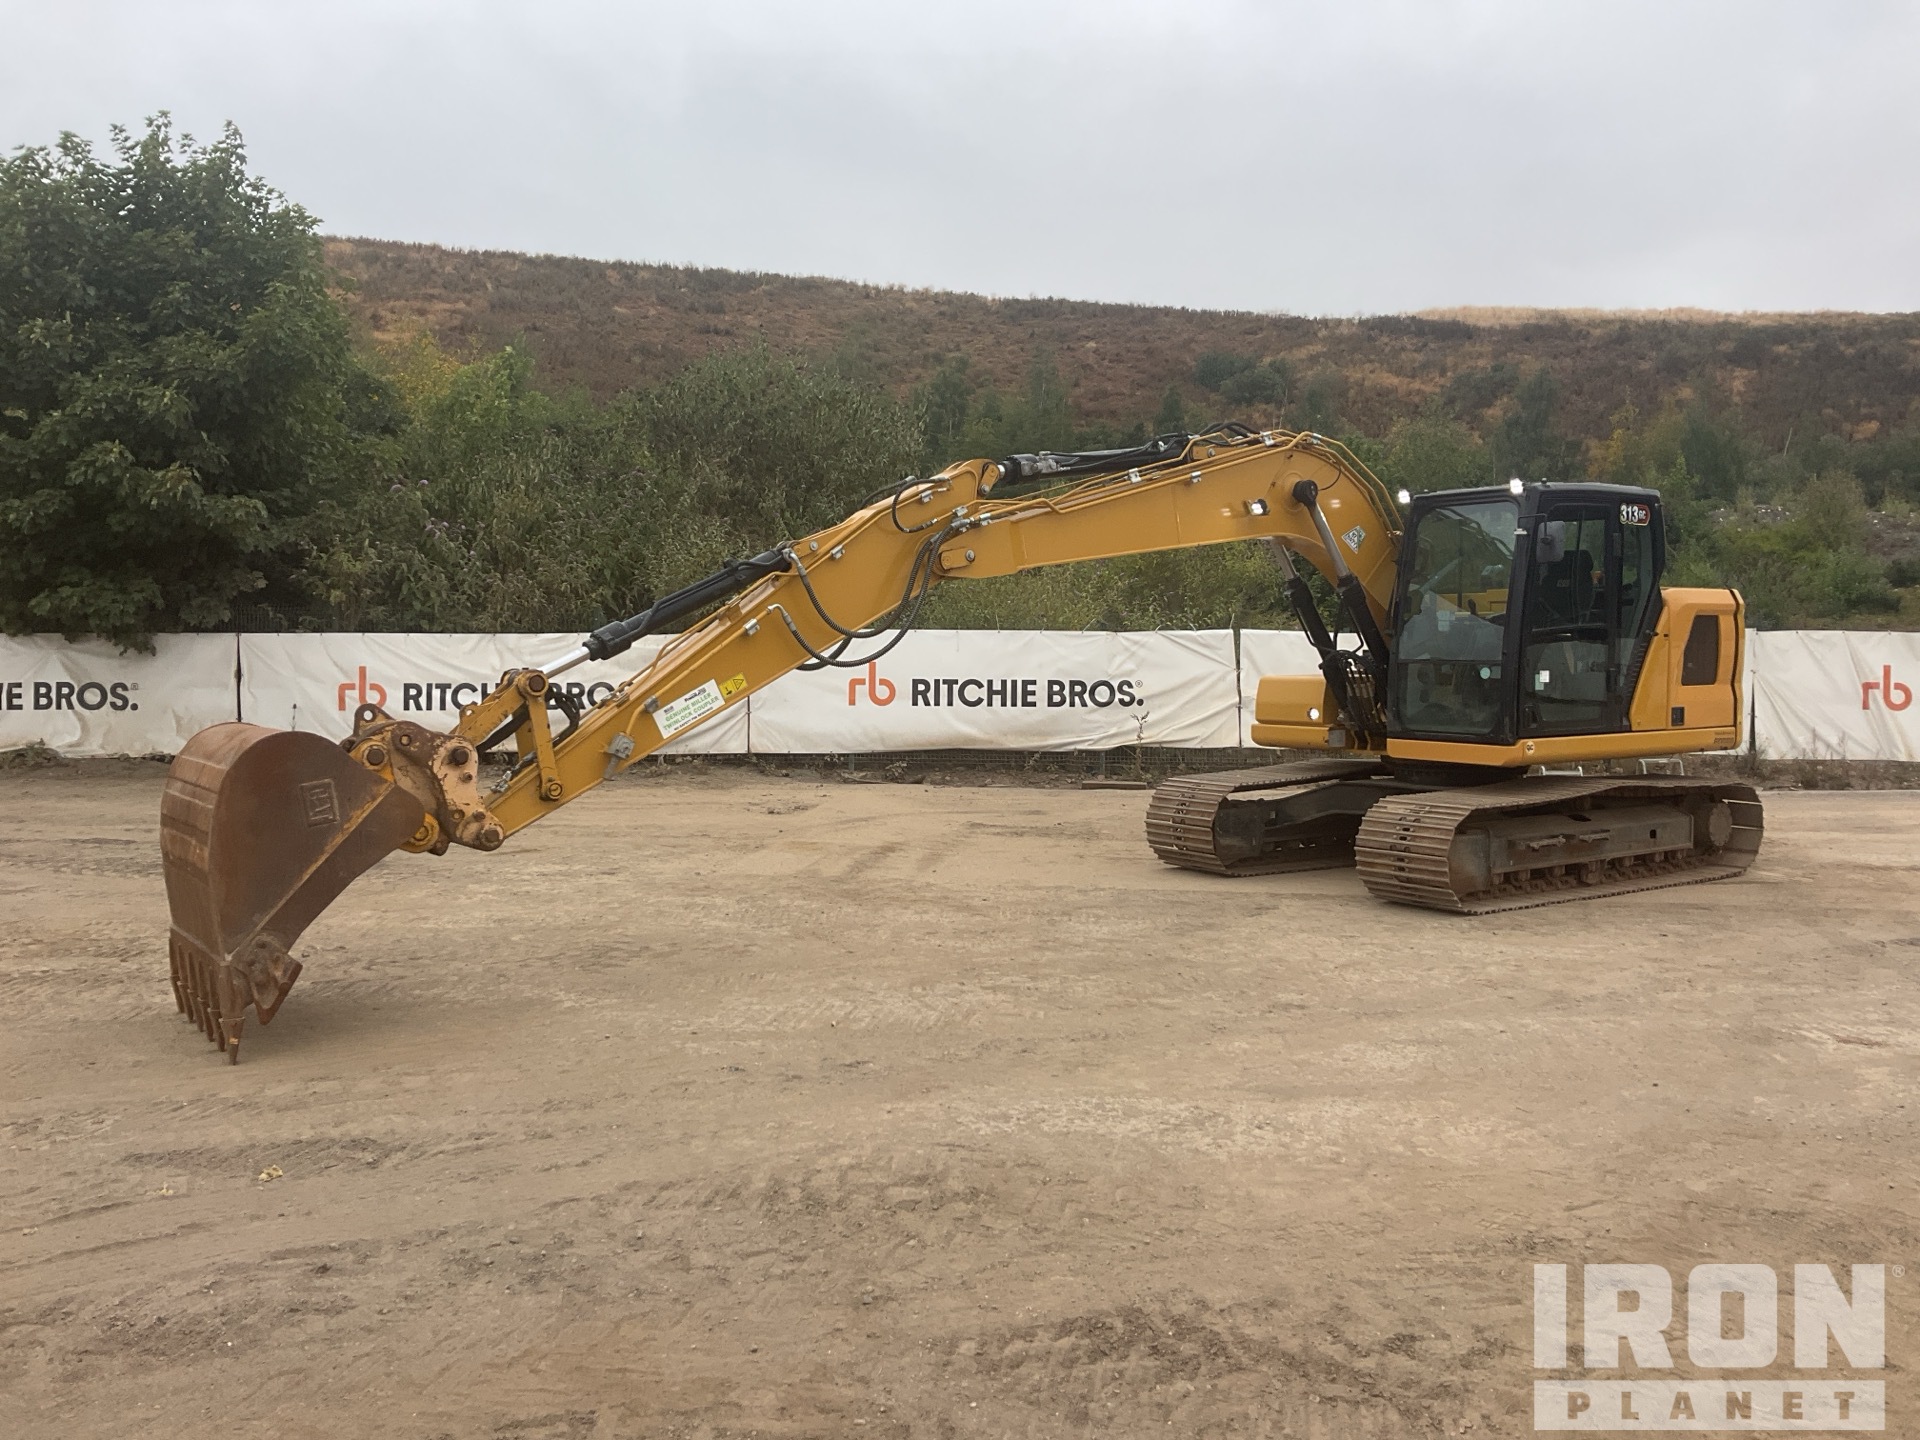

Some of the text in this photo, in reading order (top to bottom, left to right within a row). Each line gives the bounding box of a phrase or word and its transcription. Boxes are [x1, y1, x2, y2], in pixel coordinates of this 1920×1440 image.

[1620, 504, 1638, 523] 313
[33, 681, 139, 711] BROS.
[403, 683, 501, 711] RITCH
[848, 661, 1144, 708] rb RITCHIE BROS.
[1861, 665, 1913, 711] rb
[663, 711, 693, 731] TWINLOCK
[693, 695, 720, 713] COUPLER
[665, 703, 691, 722] GENUINE
[692, 692, 712, 708] MILLER
